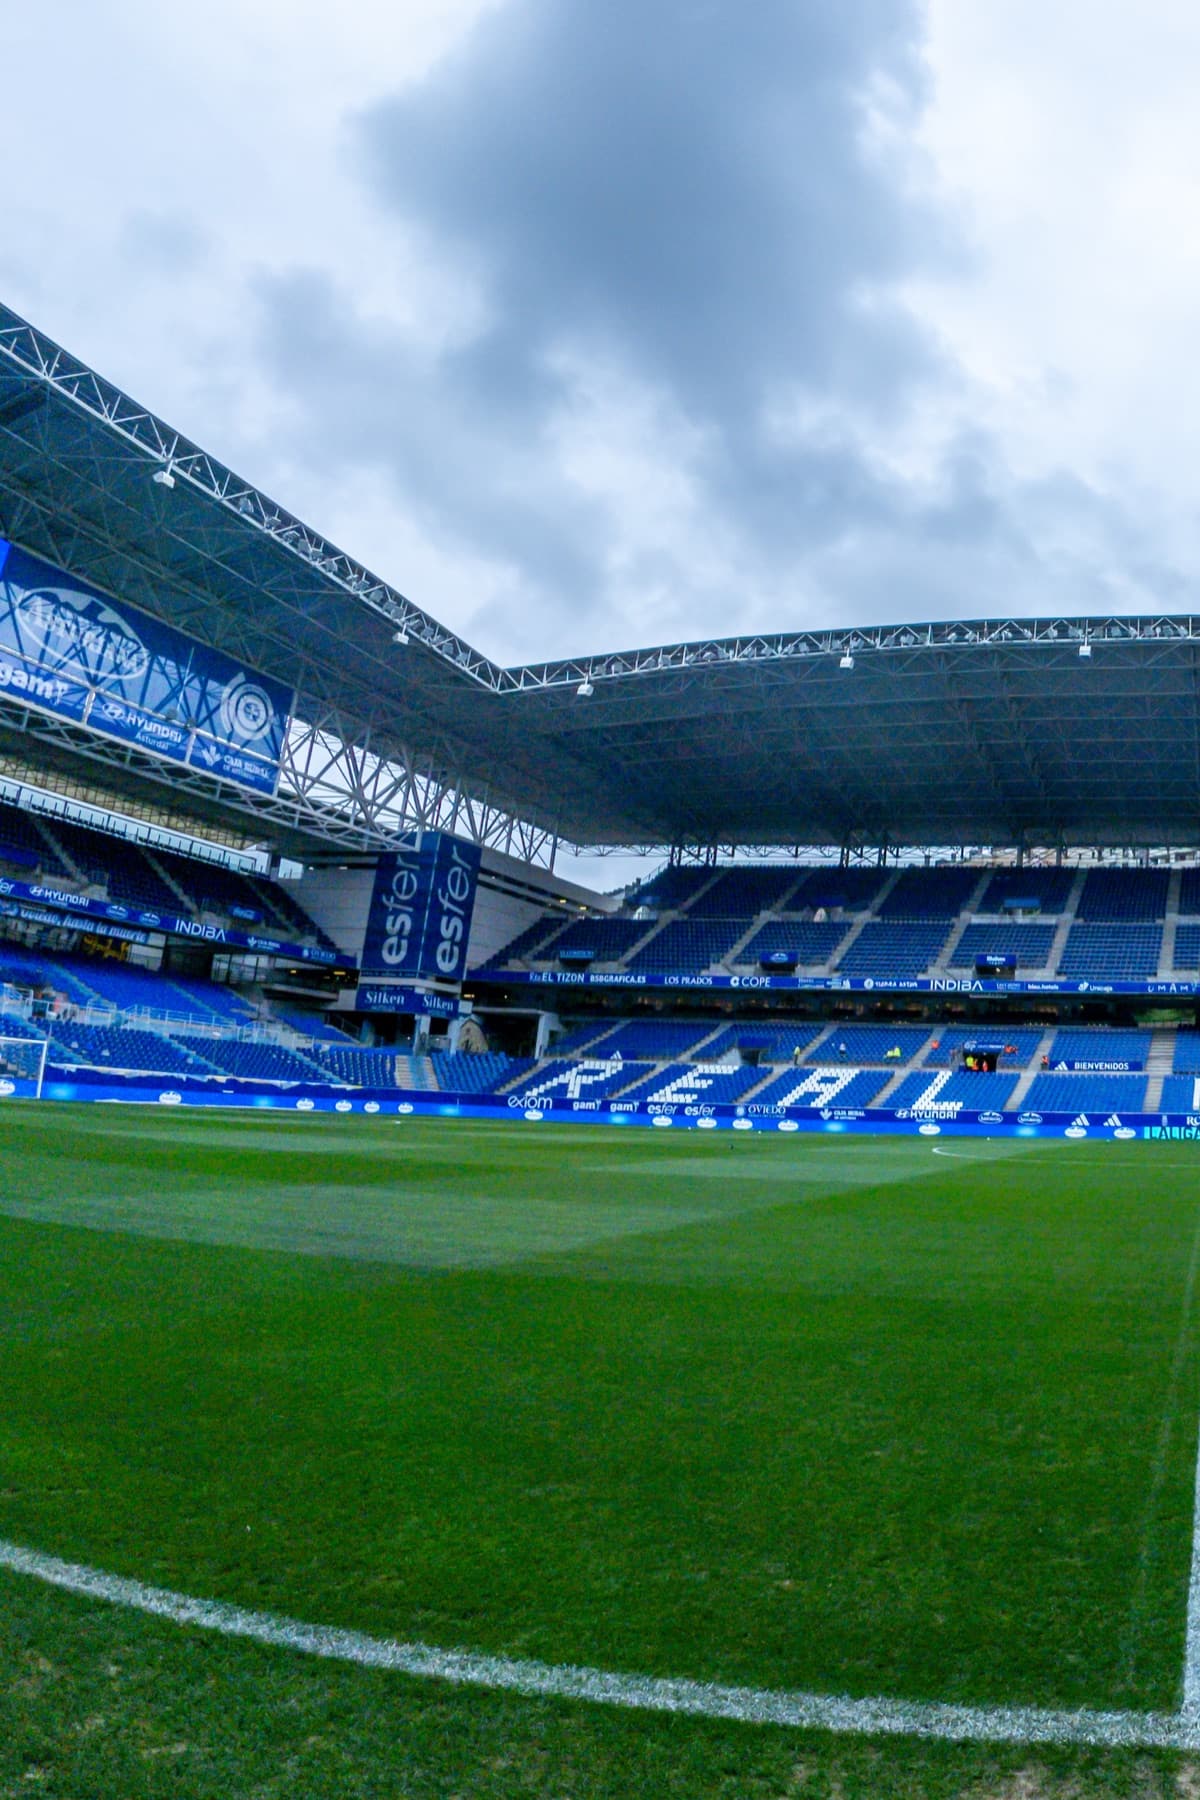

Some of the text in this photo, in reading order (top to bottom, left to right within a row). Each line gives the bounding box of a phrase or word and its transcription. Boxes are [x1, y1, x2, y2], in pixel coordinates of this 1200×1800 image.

[127, 712, 182, 743] HYUNDAI
[45, 889, 89, 907] HYUNDAI
[382, 854, 420, 965] esfer
[436, 844, 472, 973] esfer
[175, 919, 226, 942] INDIBA
[542, 972, 553, 983] EL
[664, 976, 713, 985] LOS PRADOS
[741, 976, 771, 988] COPE
[930, 979, 984, 992] INDIBA
[365, 991, 406, 1006] Silken
[422, 994, 454, 1012] Silken
[1074, 1062, 1129, 1070] BIENVENIDOS
[507, 1095, 553, 1110] exiom
[647, 1102, 678, 1115] esfer
[748, 1103, 786, 1114] OVIEDO
[684, 1103, 716, 1117] esfer
[910, 1109, 957, 1120] HYUNDAI
